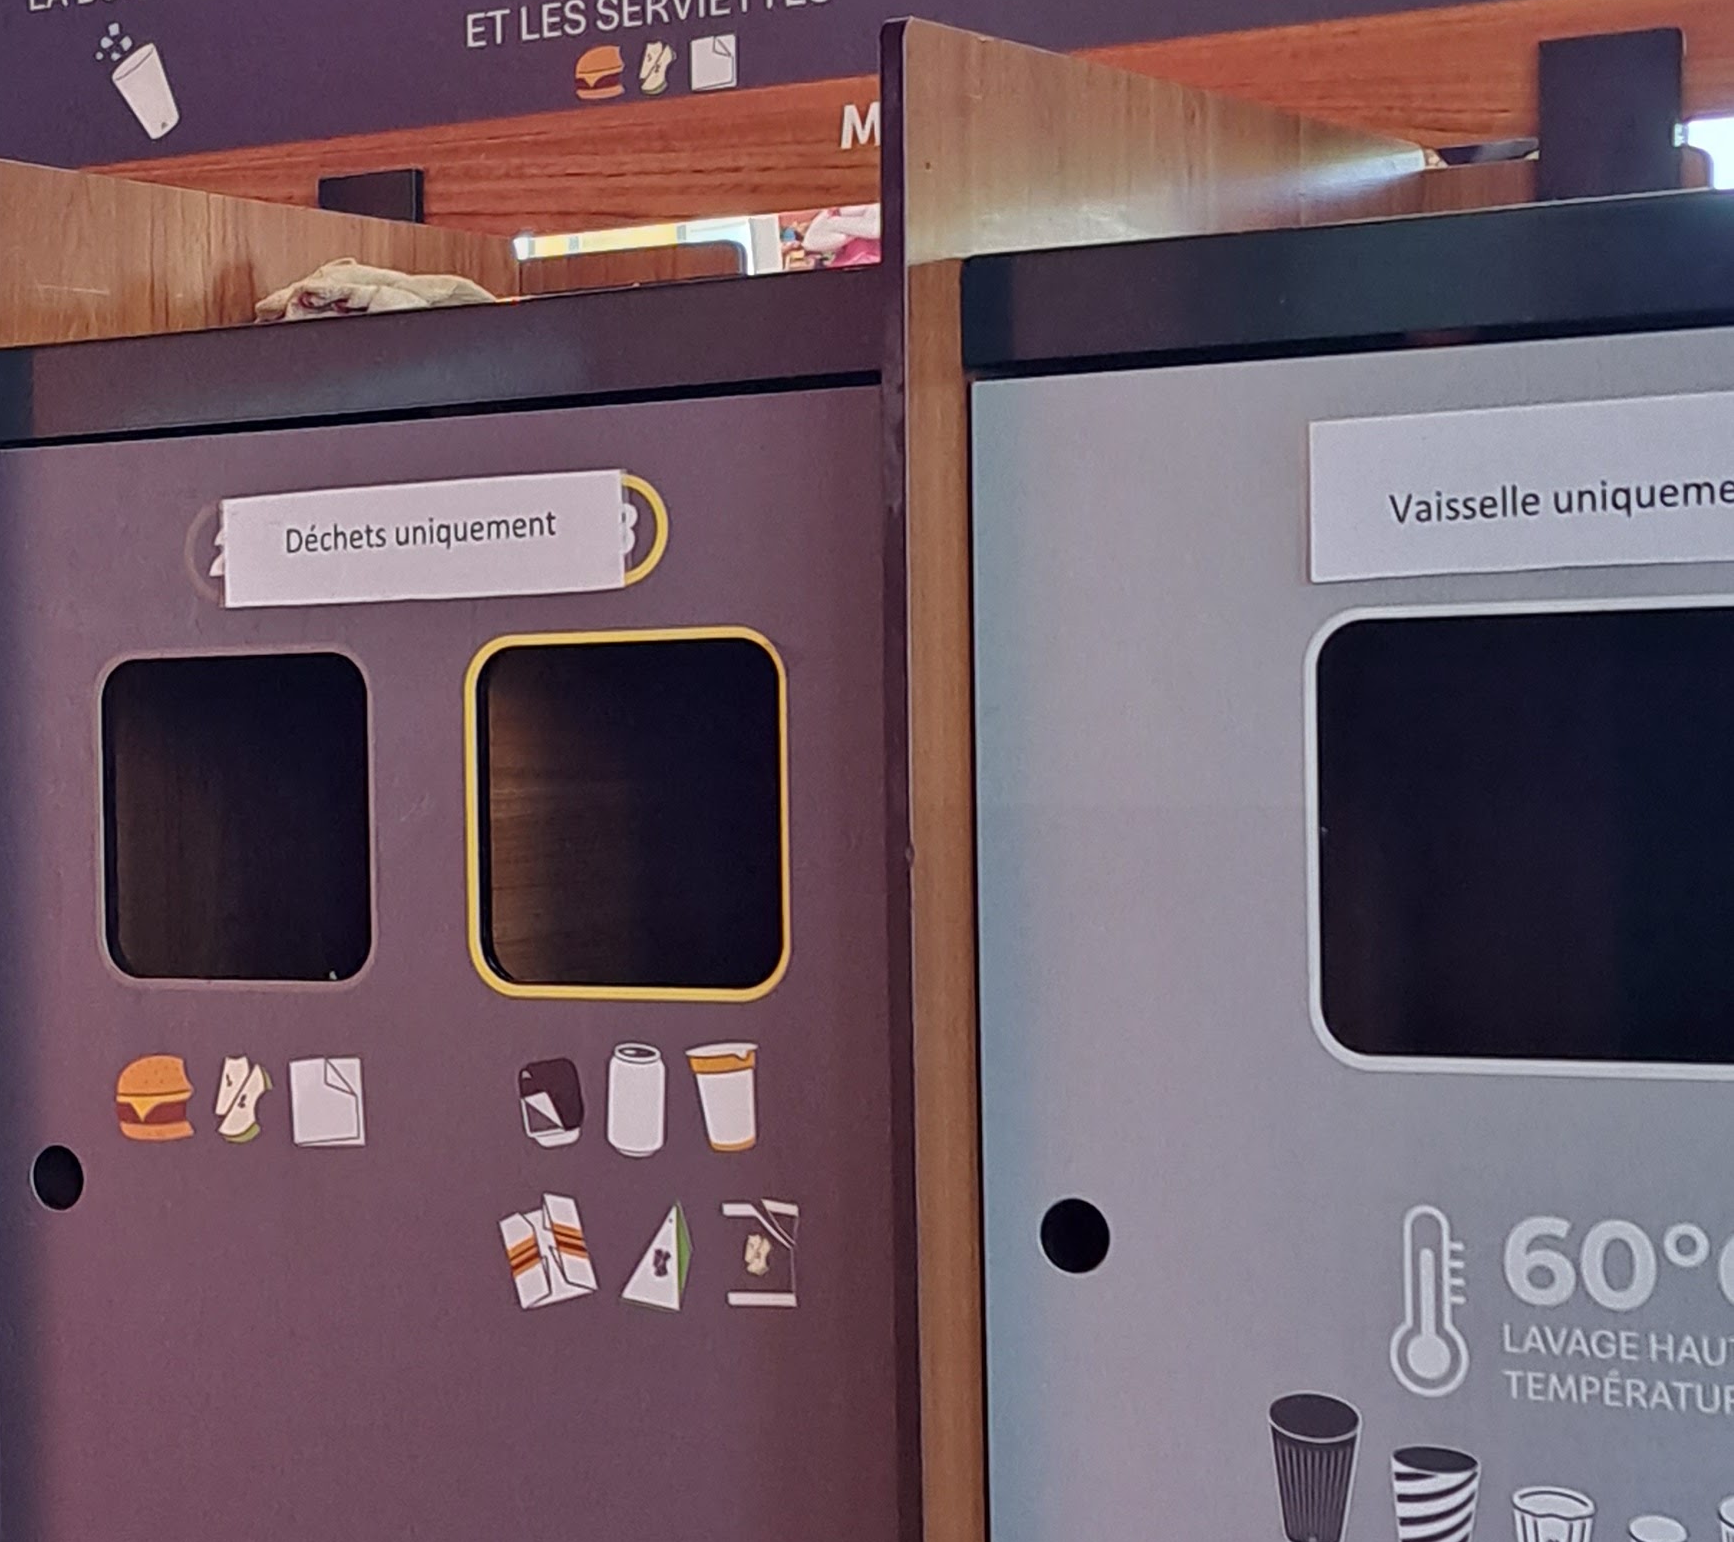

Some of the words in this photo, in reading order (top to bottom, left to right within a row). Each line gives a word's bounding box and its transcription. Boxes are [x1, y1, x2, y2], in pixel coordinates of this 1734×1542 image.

[466, 8, 510, 49] ET
[520, 0, 587, 41] LES
[1388, 483, 1541, 525] Vaisselle
[285, 524, 387, 555] Déchets
[394, 510, 557, 550] uniquement
[1503, 1215, 1734, 1312] 60°
[1502, 1322, 1640, 1361] LAVAGE
[1649, 1332, 1734, 1367] HAU
